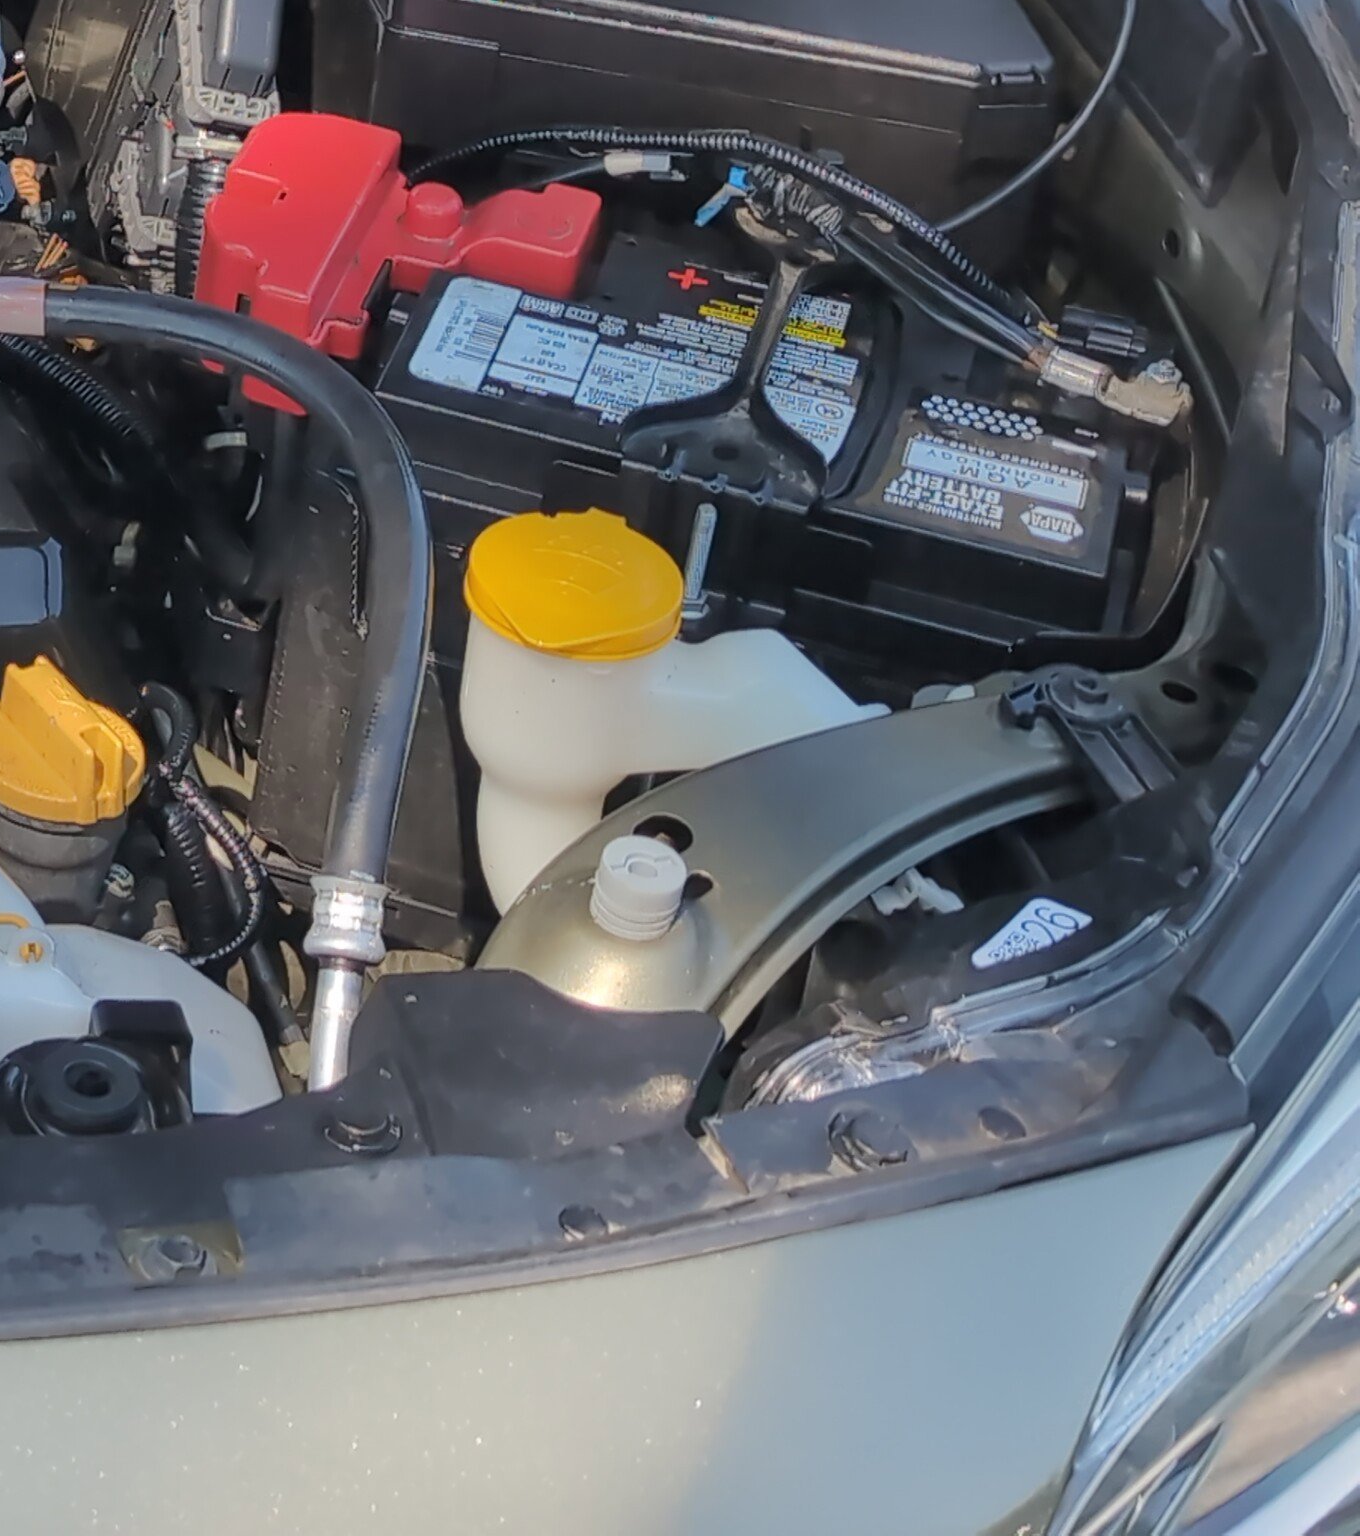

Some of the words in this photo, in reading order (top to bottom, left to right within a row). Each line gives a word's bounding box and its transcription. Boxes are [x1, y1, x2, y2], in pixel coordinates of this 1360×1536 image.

[897, 465, 1002, 505] BATTERY
[925, 446, 1068, 489] TECHNOLOGY
[883, 477, 1005, 520] EXACT-FIT
[1028, 510, 1076, 536] NAPA
